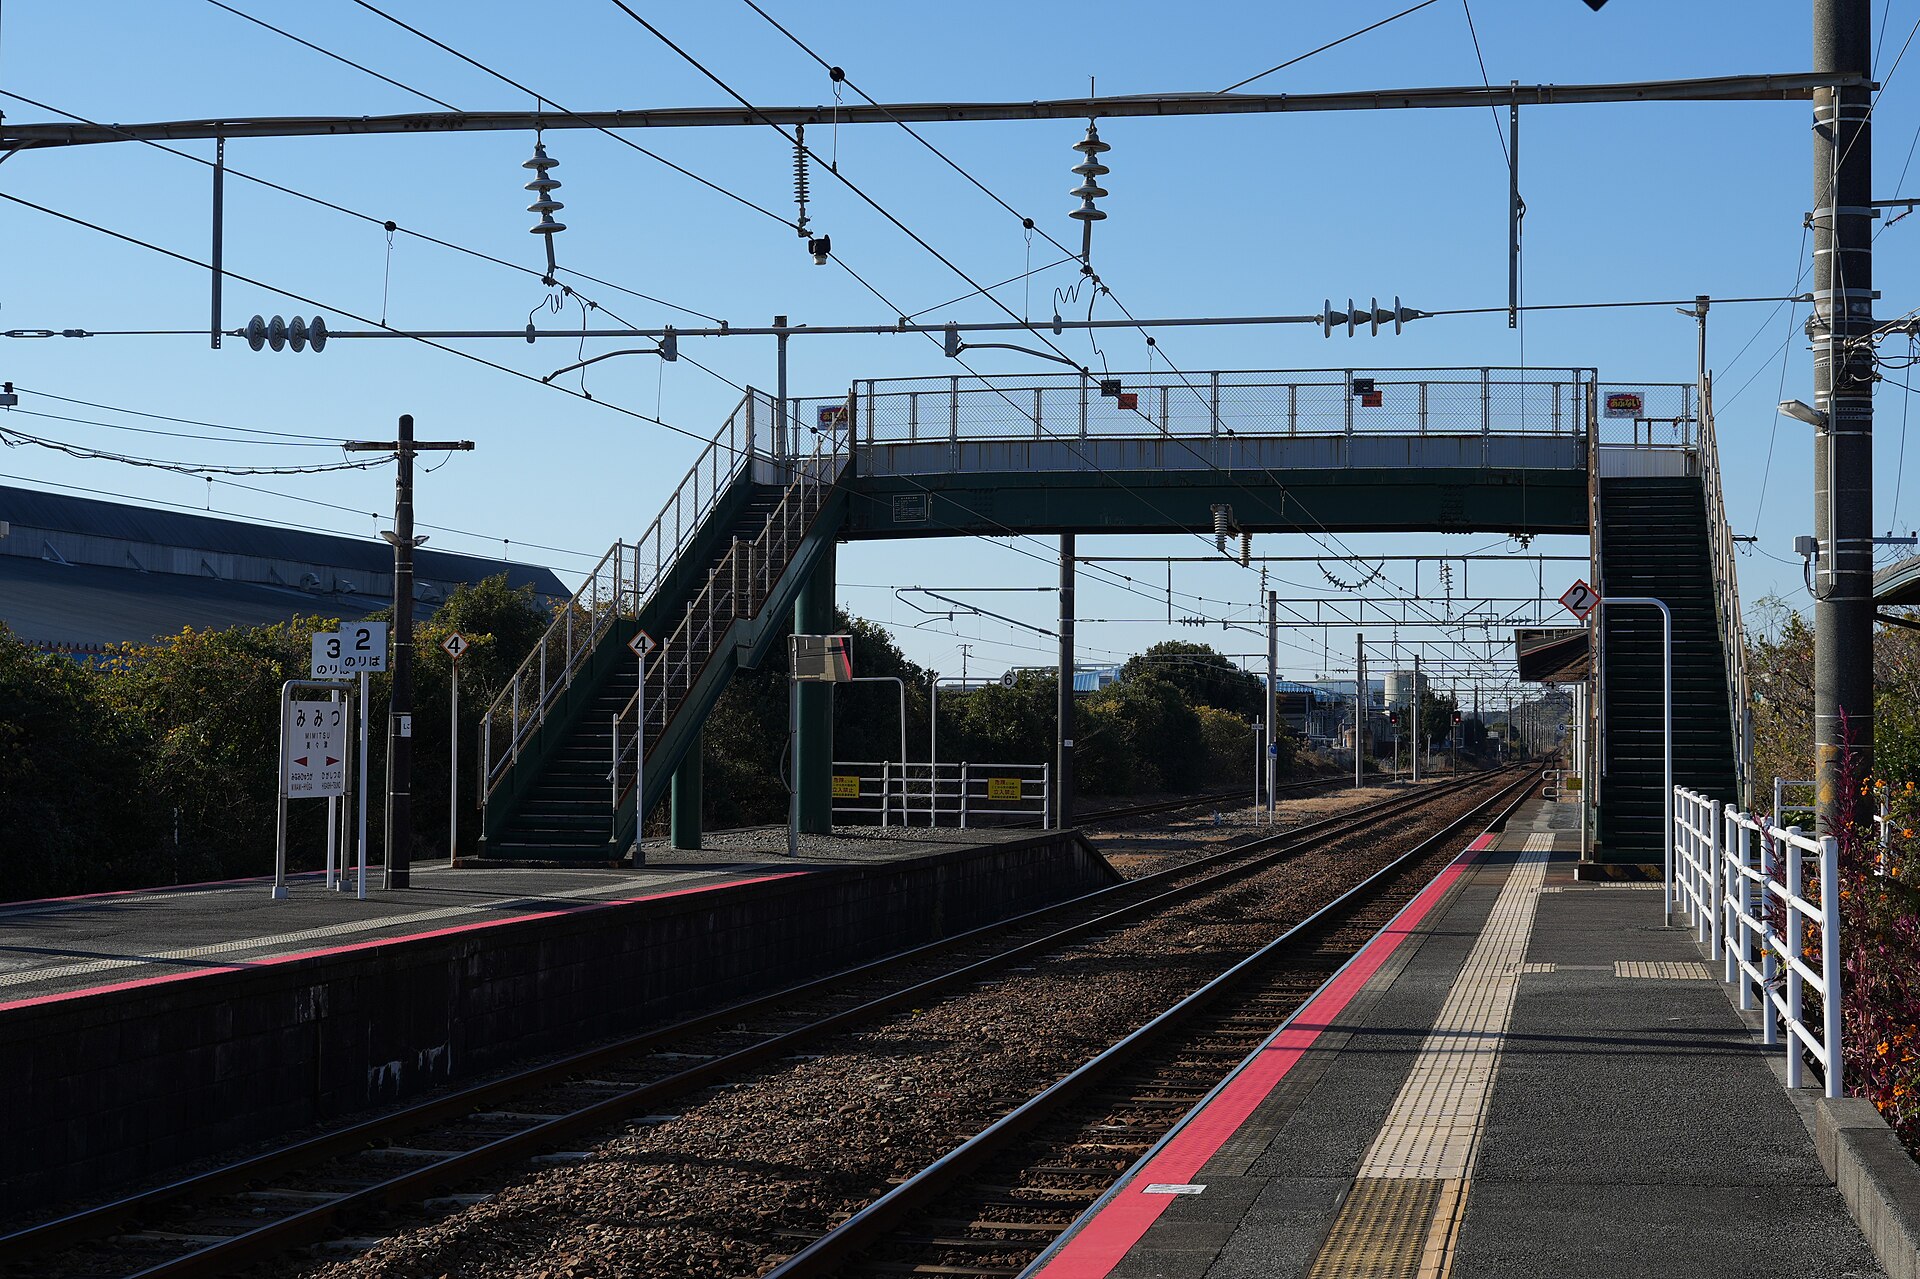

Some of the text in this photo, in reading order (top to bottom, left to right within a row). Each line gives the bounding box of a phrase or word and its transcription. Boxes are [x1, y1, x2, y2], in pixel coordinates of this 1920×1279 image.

[1572, 586, 1588, 610] 2
[326, 638, 341, 659] 3
[355, 628, 371, 651] 2
[447, 637, 461, 653] 4
[634, 636, 648, 654] 4
[344, 655, 381, 668] のりば
[1004, 673, 1013, 686] 6
[296, 709, 341, 728] みみつ
[1558, 723, 1565, 731] 6
